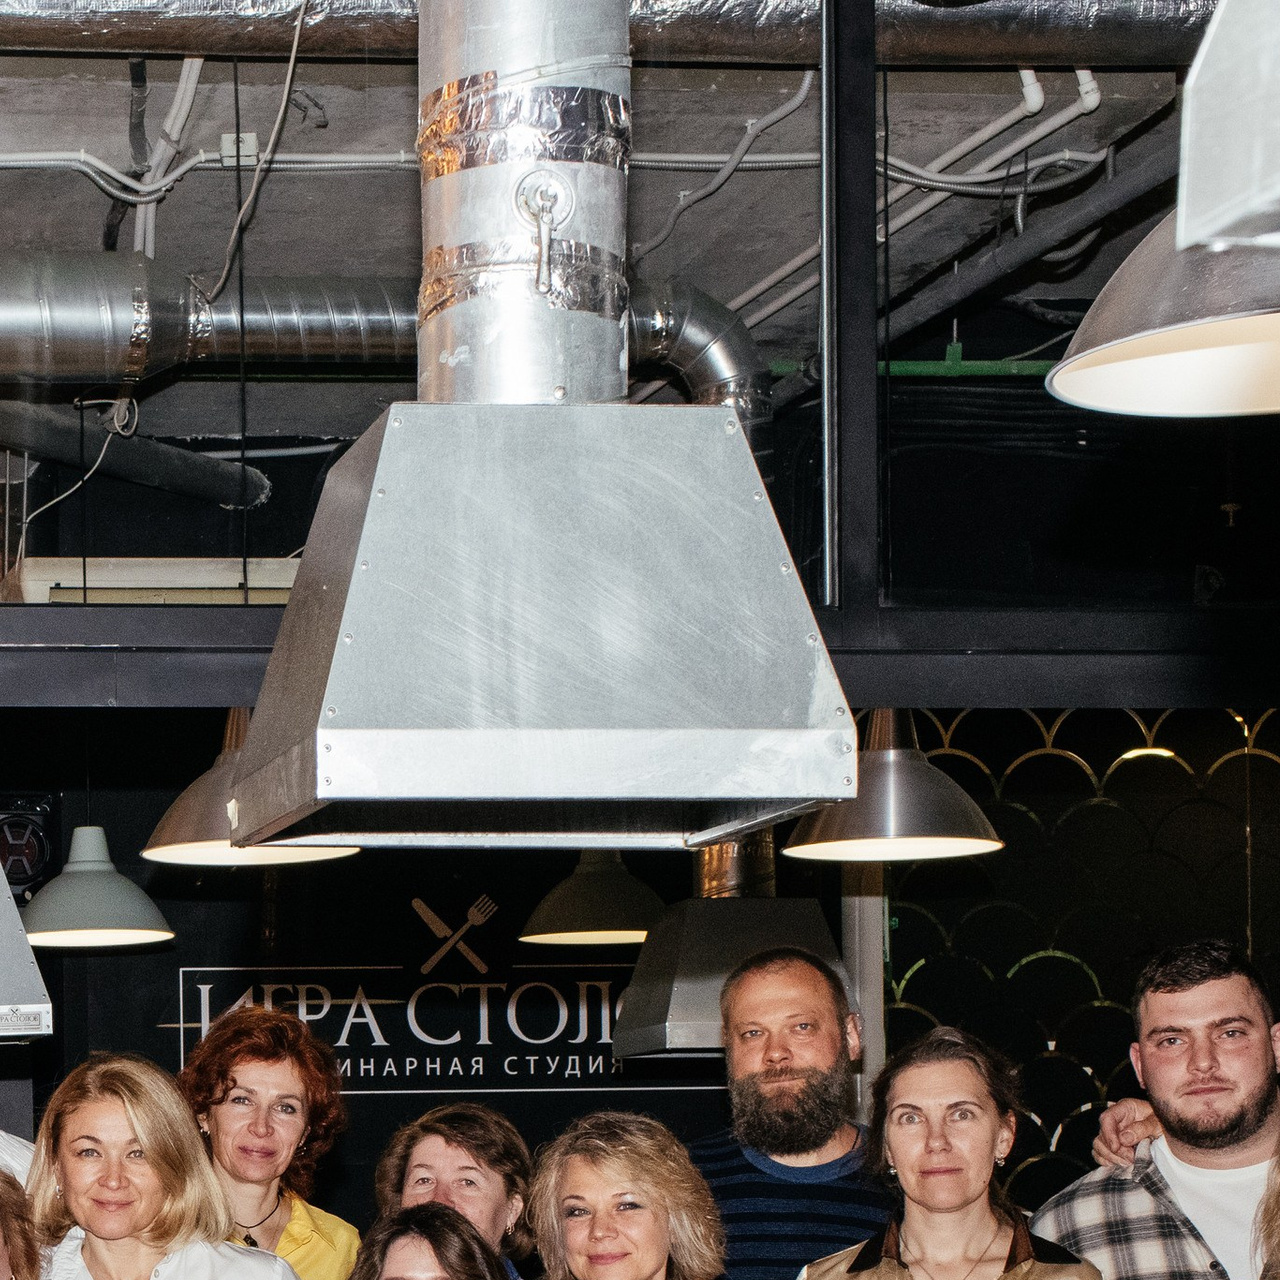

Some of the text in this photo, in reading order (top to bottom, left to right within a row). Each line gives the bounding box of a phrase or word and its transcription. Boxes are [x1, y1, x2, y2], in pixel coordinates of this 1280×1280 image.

[406, 980, 624, 1046] СТОЛ
[336, 1055, 623, 1079] ИНАРНАЯ СТУДИЯ
